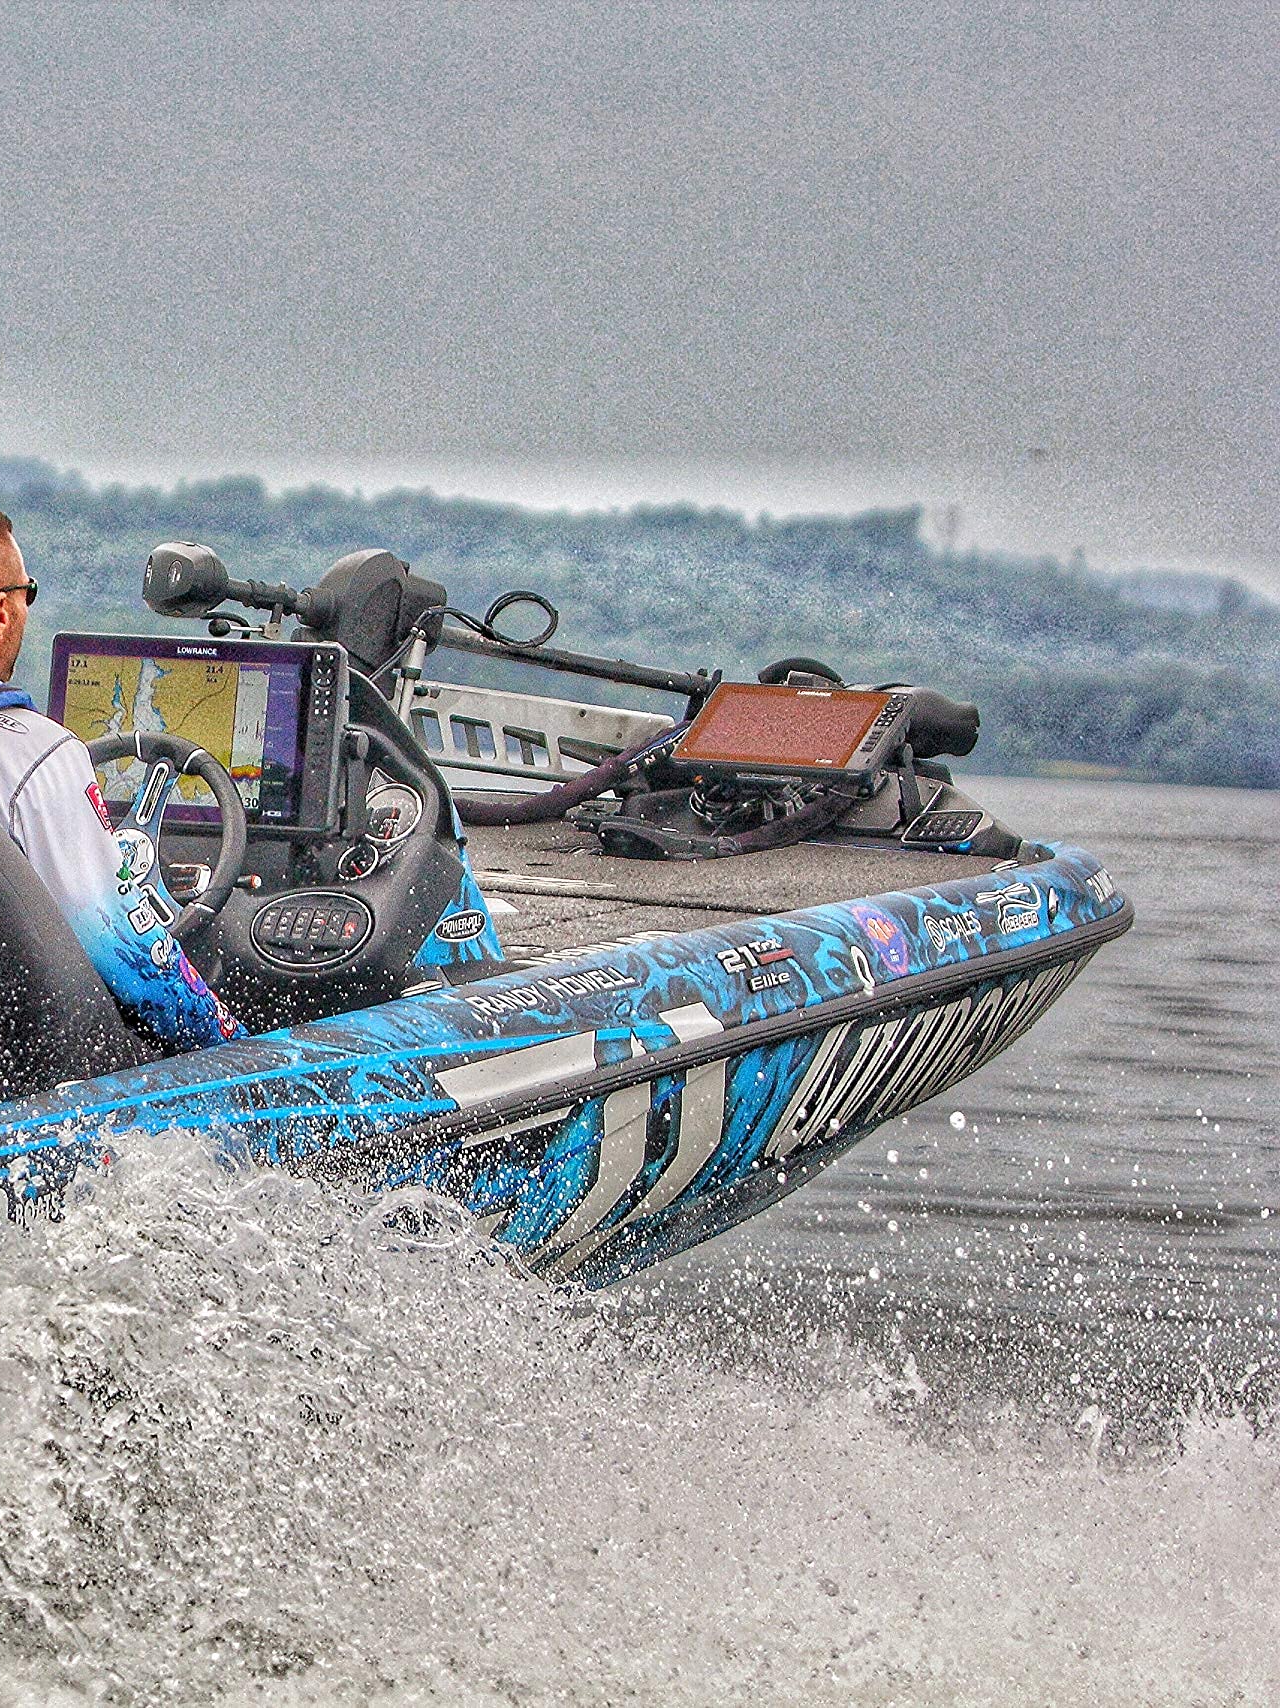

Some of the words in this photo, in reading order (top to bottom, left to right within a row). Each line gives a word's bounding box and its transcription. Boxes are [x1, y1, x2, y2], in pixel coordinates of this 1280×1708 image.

[177, 646, 217, 656] LOWRANCE
[70, 659, 88, 668] 17.1
[244, 797, 259, 808] 30
[939, 910, 982, 942] SCALES
[717, 944, 759, 974] 21
[464, 984, 548, 1017] RANDY
[537, 966, 636, 999] HOWELL
[749, 971, 791, 992] Elite
